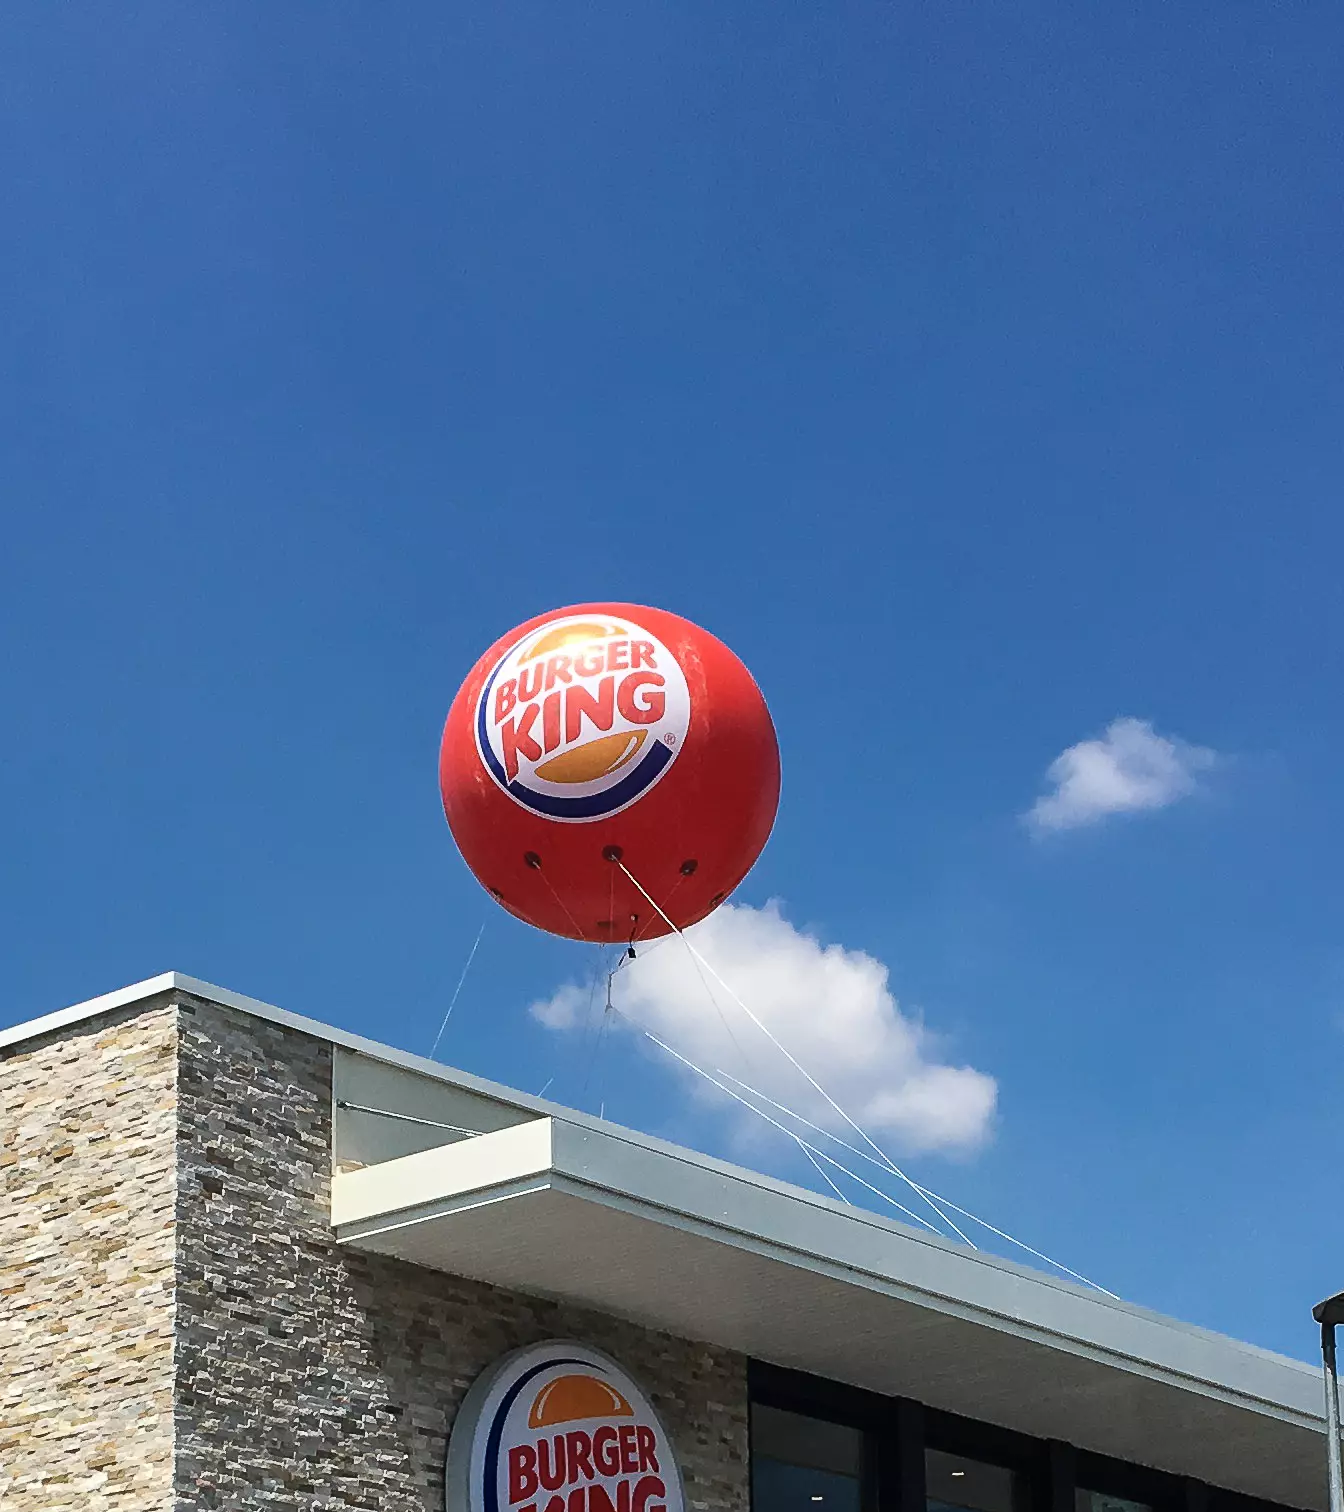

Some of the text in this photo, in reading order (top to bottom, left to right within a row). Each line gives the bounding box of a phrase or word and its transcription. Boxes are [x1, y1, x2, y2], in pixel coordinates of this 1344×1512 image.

[495, 640, 658, 725] BURGER
[501, 671, 666, 782] KING
[508, 1425, 660, 1505] BURGER
